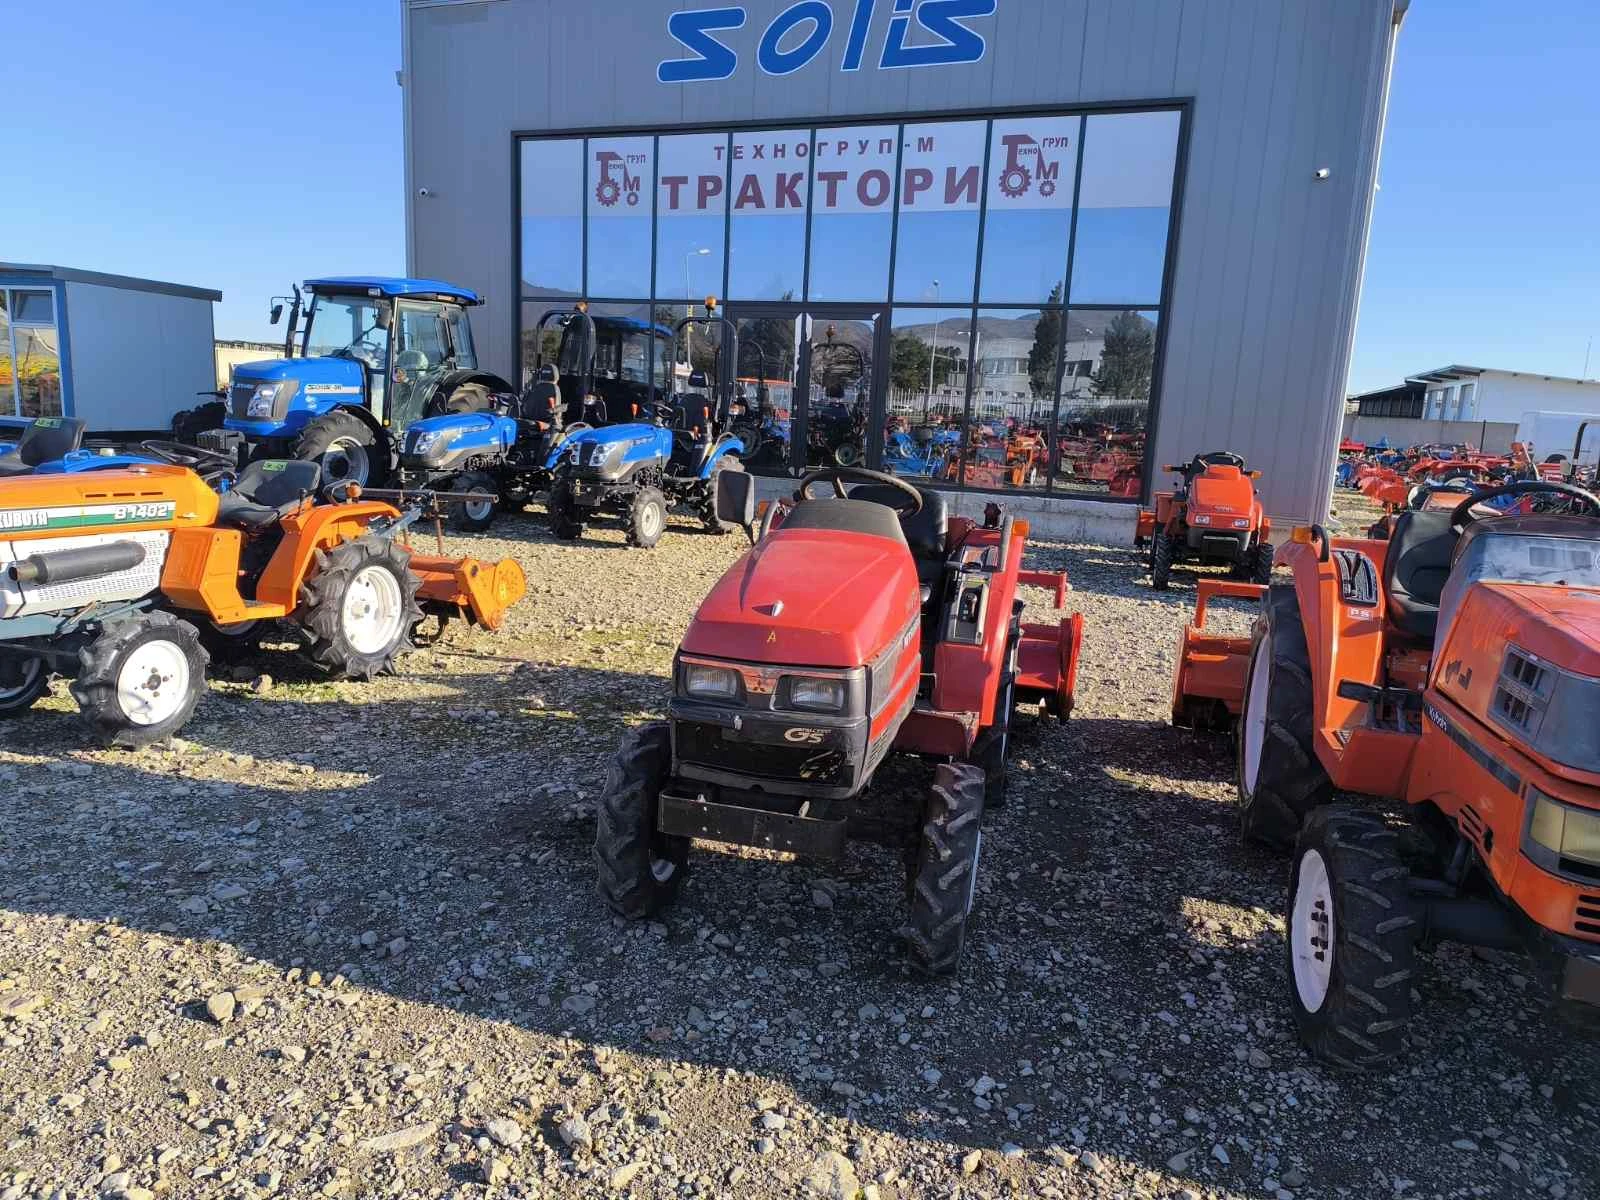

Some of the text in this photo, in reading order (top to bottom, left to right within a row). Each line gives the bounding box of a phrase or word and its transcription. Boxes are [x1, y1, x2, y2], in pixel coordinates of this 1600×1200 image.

[714, 137, 935, 161] ТЕХНОГРУП-М
[1042, 136, 1068, 148] ГРУП
[661, 166, 980, 210] ТРАКТОРИ
